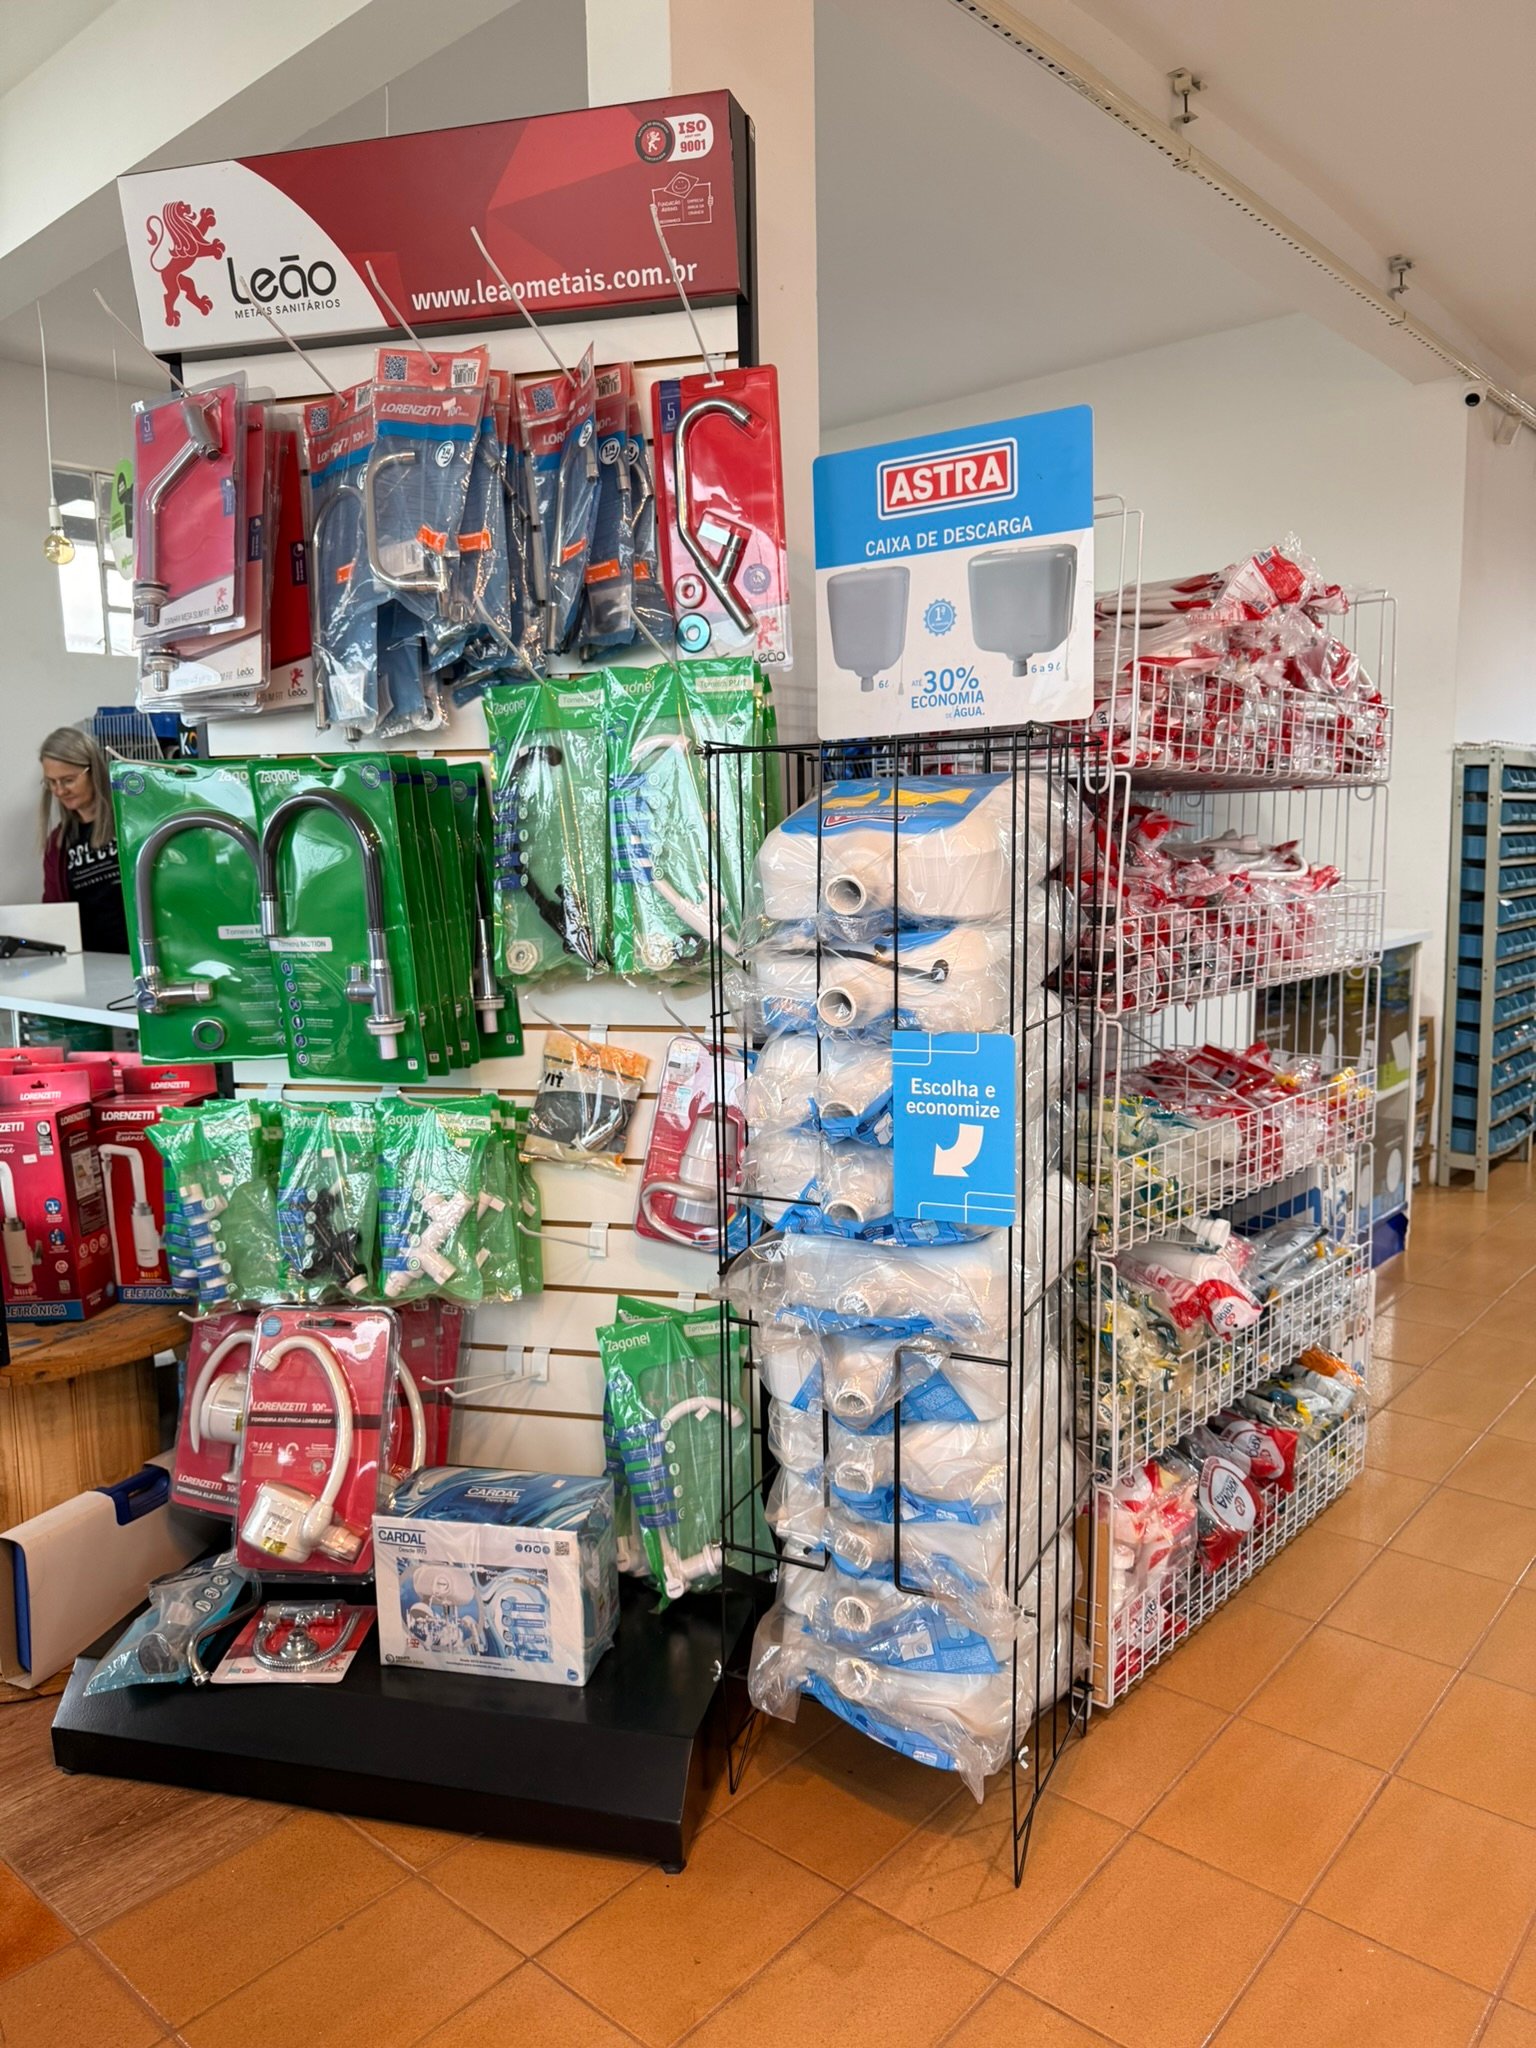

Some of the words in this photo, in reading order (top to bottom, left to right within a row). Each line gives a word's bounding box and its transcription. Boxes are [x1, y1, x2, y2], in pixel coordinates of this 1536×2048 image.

[678, 119, 707, 135] ISO
[680, 138, 706, 153] 9001
[411, 257, 698, 311] www.leaometais.com.br
[275, 298, 341, 315] SANITÁRIOS
[381, 401, 440, 417] LORENZETTI
[667, 401, 676, 421] 5
[889, 455, 1005, 505] ASTRA
[865, 535, 911, 556] CAIXA
[916, 531, 938, 549] DE
[943, 515, 1033, 545] DESCARGA
[1031, 663, 1037, 673] 6
[1039, 664, 1045, 673] a
[1047, 662, 1054, 672] 9
[923, 665, 979, 694] 30%
[911, 690, 985, 709] ECONOMIA
[953, 706, 985, 718] ÁGUA.
[150, 1081, 190, 1090] LORENZETTI
[911, 1077, 979, 1098] Escolha
[985, 1085, 996, 1099] e
[20, 1091, 61, 1101] LORENZETTI
[102, 1110, 155, 1121] LORENZETTI
[906, 1100, 1000, 1119] economize
[0, 1121, 24, 1132] ZETTI
[6, 1303, 68, 1318] LETRÔNICA
[605, 1332, 650, 1353] Zagonel
[252, 1401, 307, 1412] LORENZETTI
[259, 1442, 273, 1450] 1/4
[178, 1473, 223, 1491] LORENZETTI
[467, 1488, 521, 1498] CARDAL
[1216, 1477, 1239, 1509] KRONA
[378, 1530, 425, 1545] CARDAL
